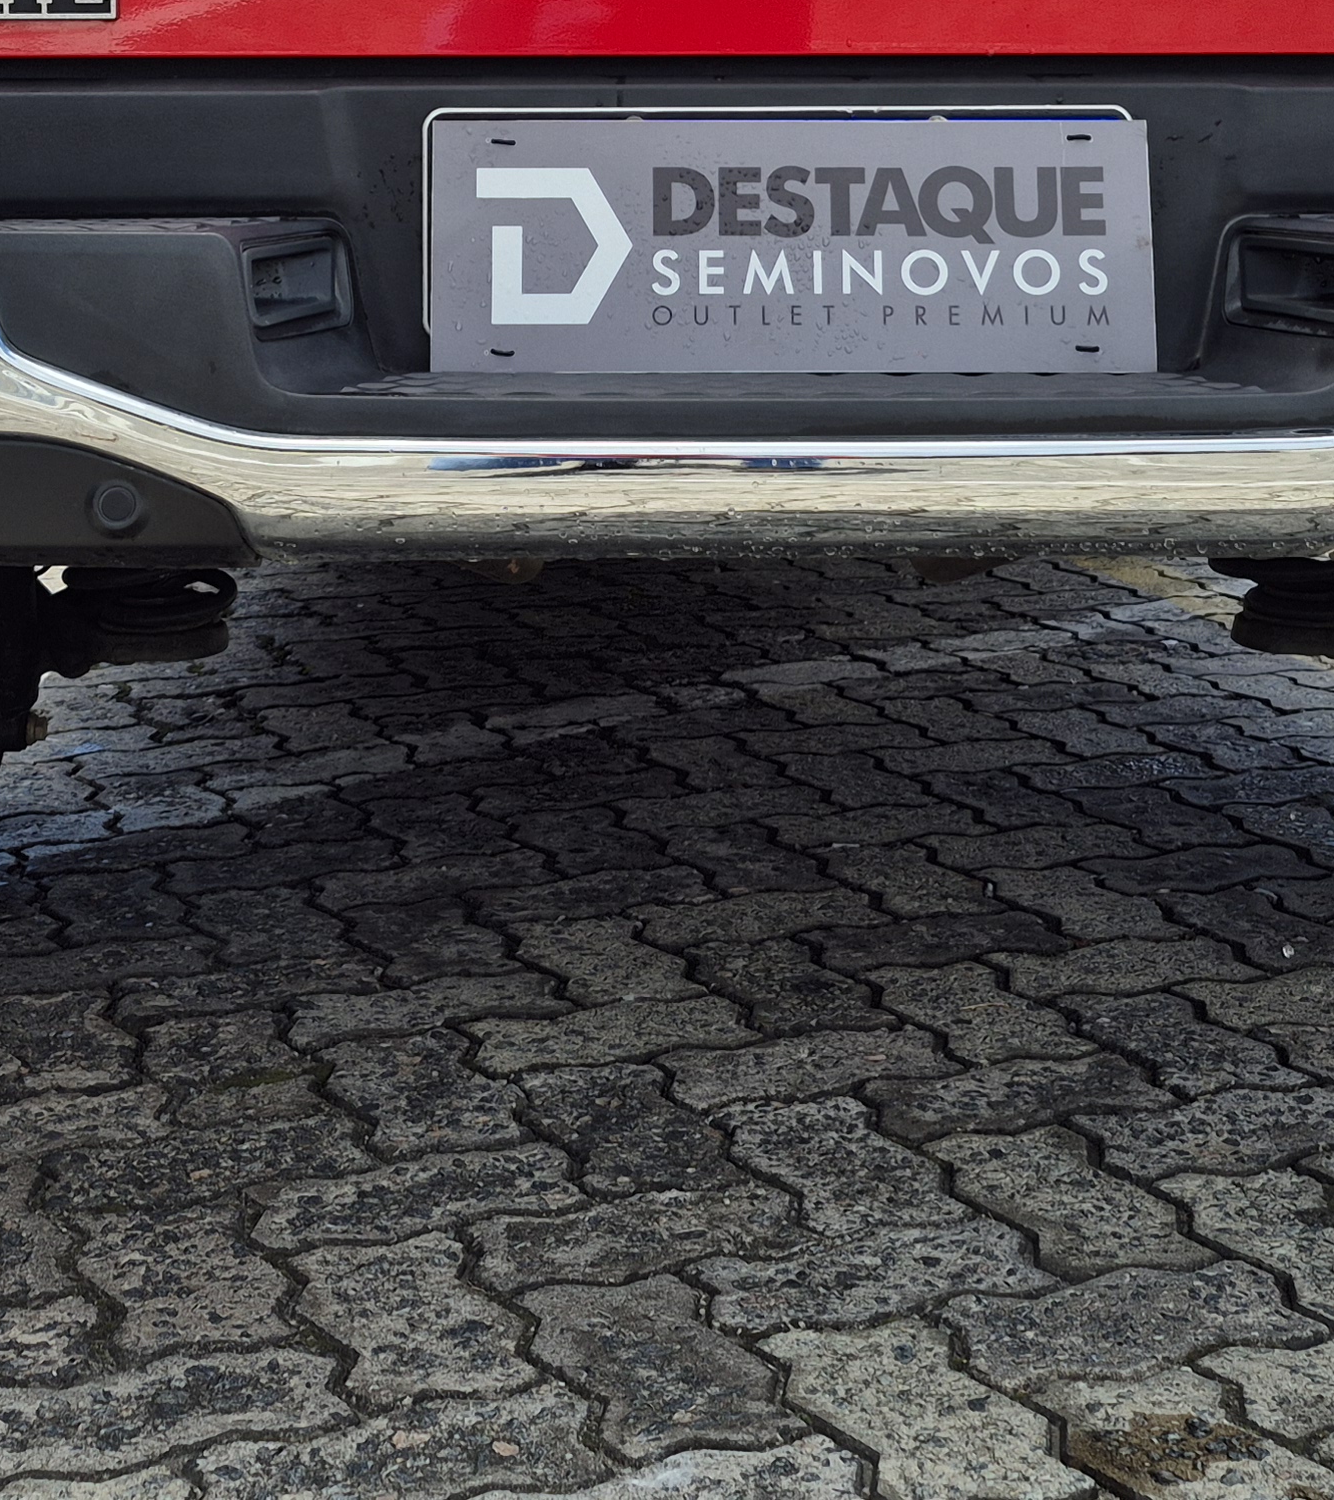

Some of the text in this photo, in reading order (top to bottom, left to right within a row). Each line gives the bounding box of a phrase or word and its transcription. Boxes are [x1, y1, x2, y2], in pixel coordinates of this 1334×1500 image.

[651, 165, 1107, 245] DESTAQUE
[651, 249, 1110, 297] SEMINOVOS
[652, 304, 1111, 327] OUTLET PREMIUM
